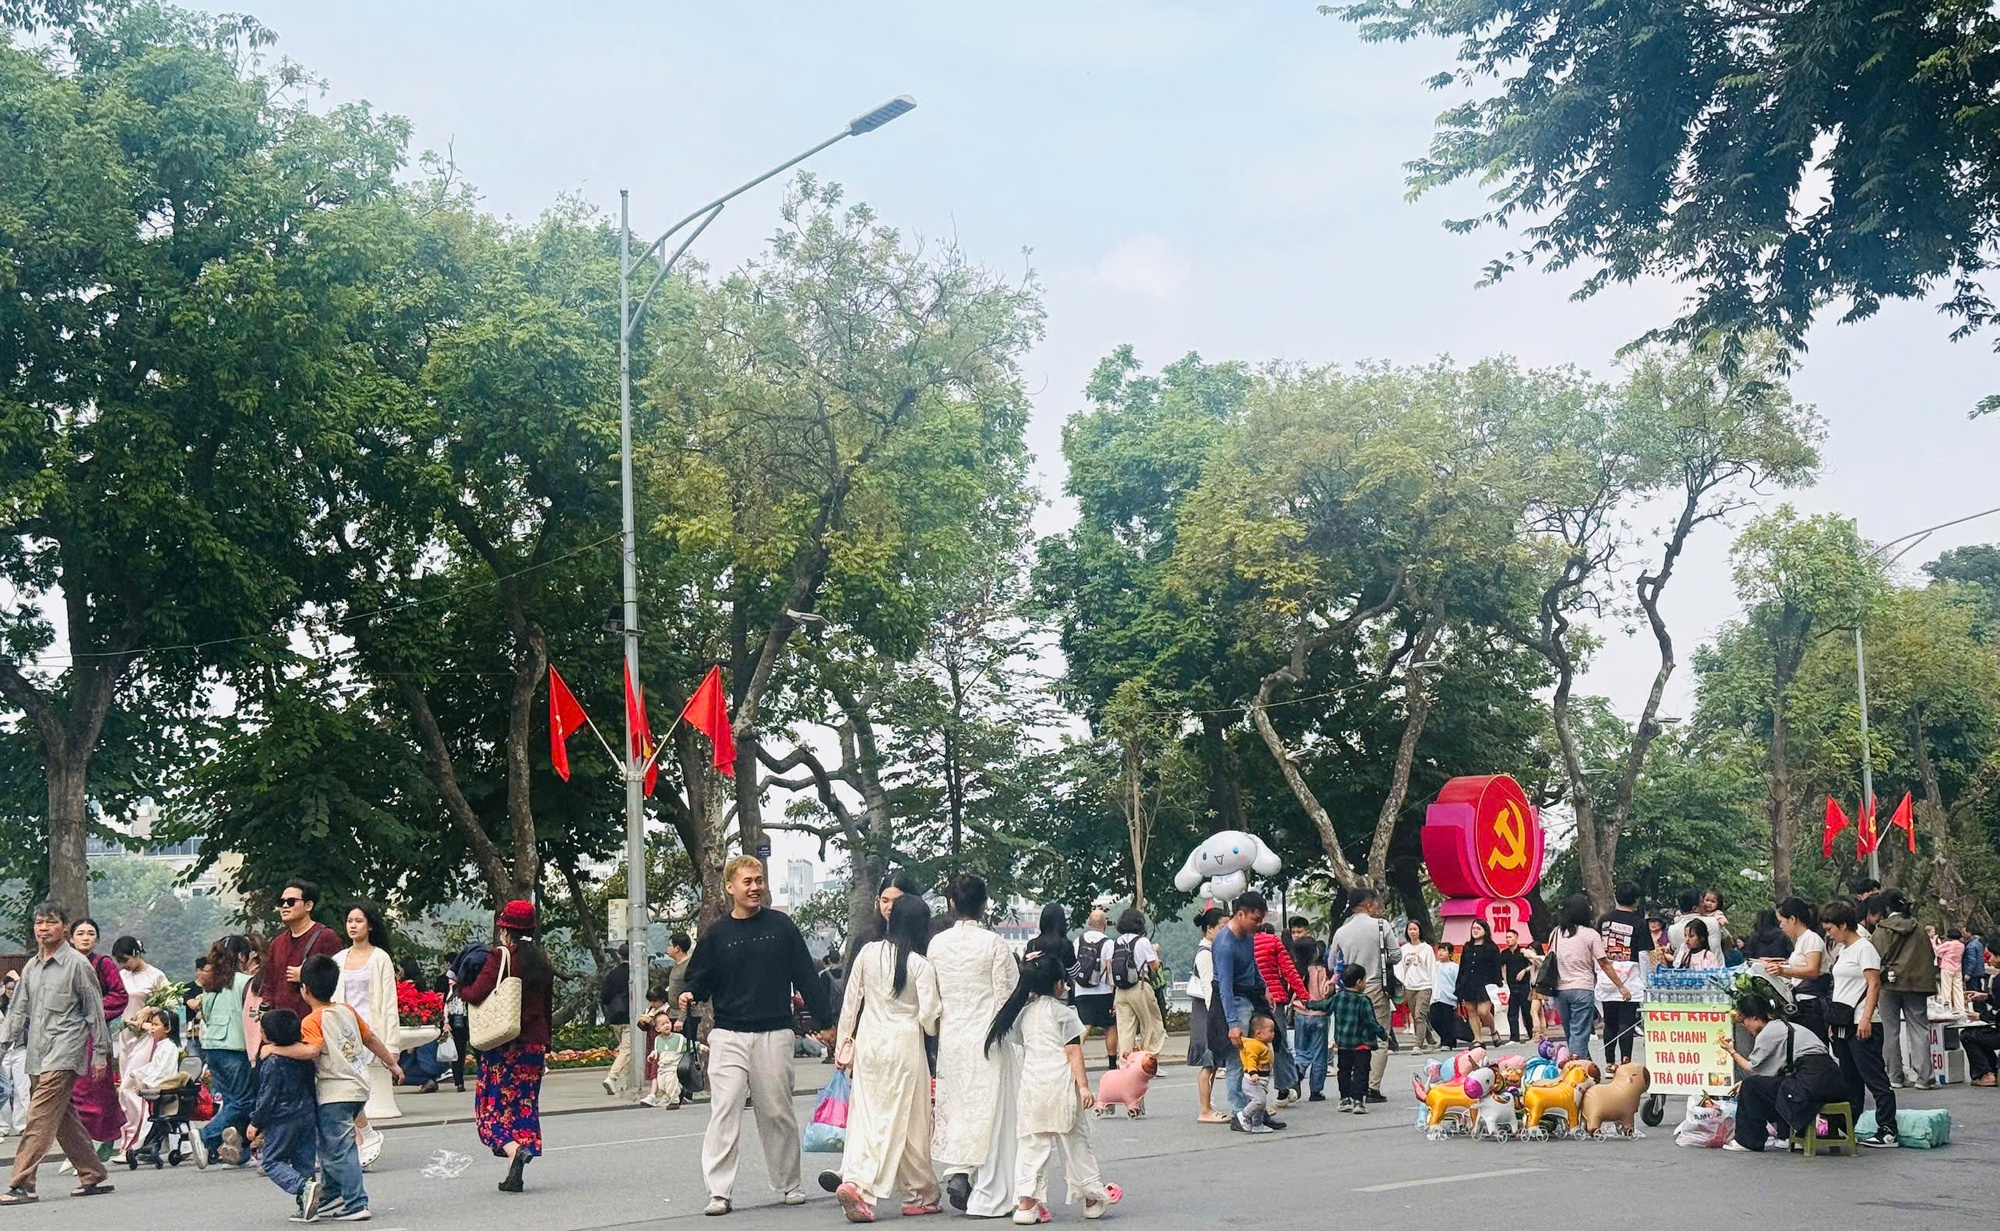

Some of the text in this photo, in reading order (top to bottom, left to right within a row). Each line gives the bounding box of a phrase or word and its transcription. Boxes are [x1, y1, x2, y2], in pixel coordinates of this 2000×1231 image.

[1493, 917, 1511, 932] XIV
[1649, 1010, 1681, 1022] KEM
[1646, 1028, 1707, 1043] TRÀ CHANH
[1655, 1049, 1700, 1064] TRÀ ĐÀO
[1653, 1069, 1704, 1087] TRÀ QUẤT
